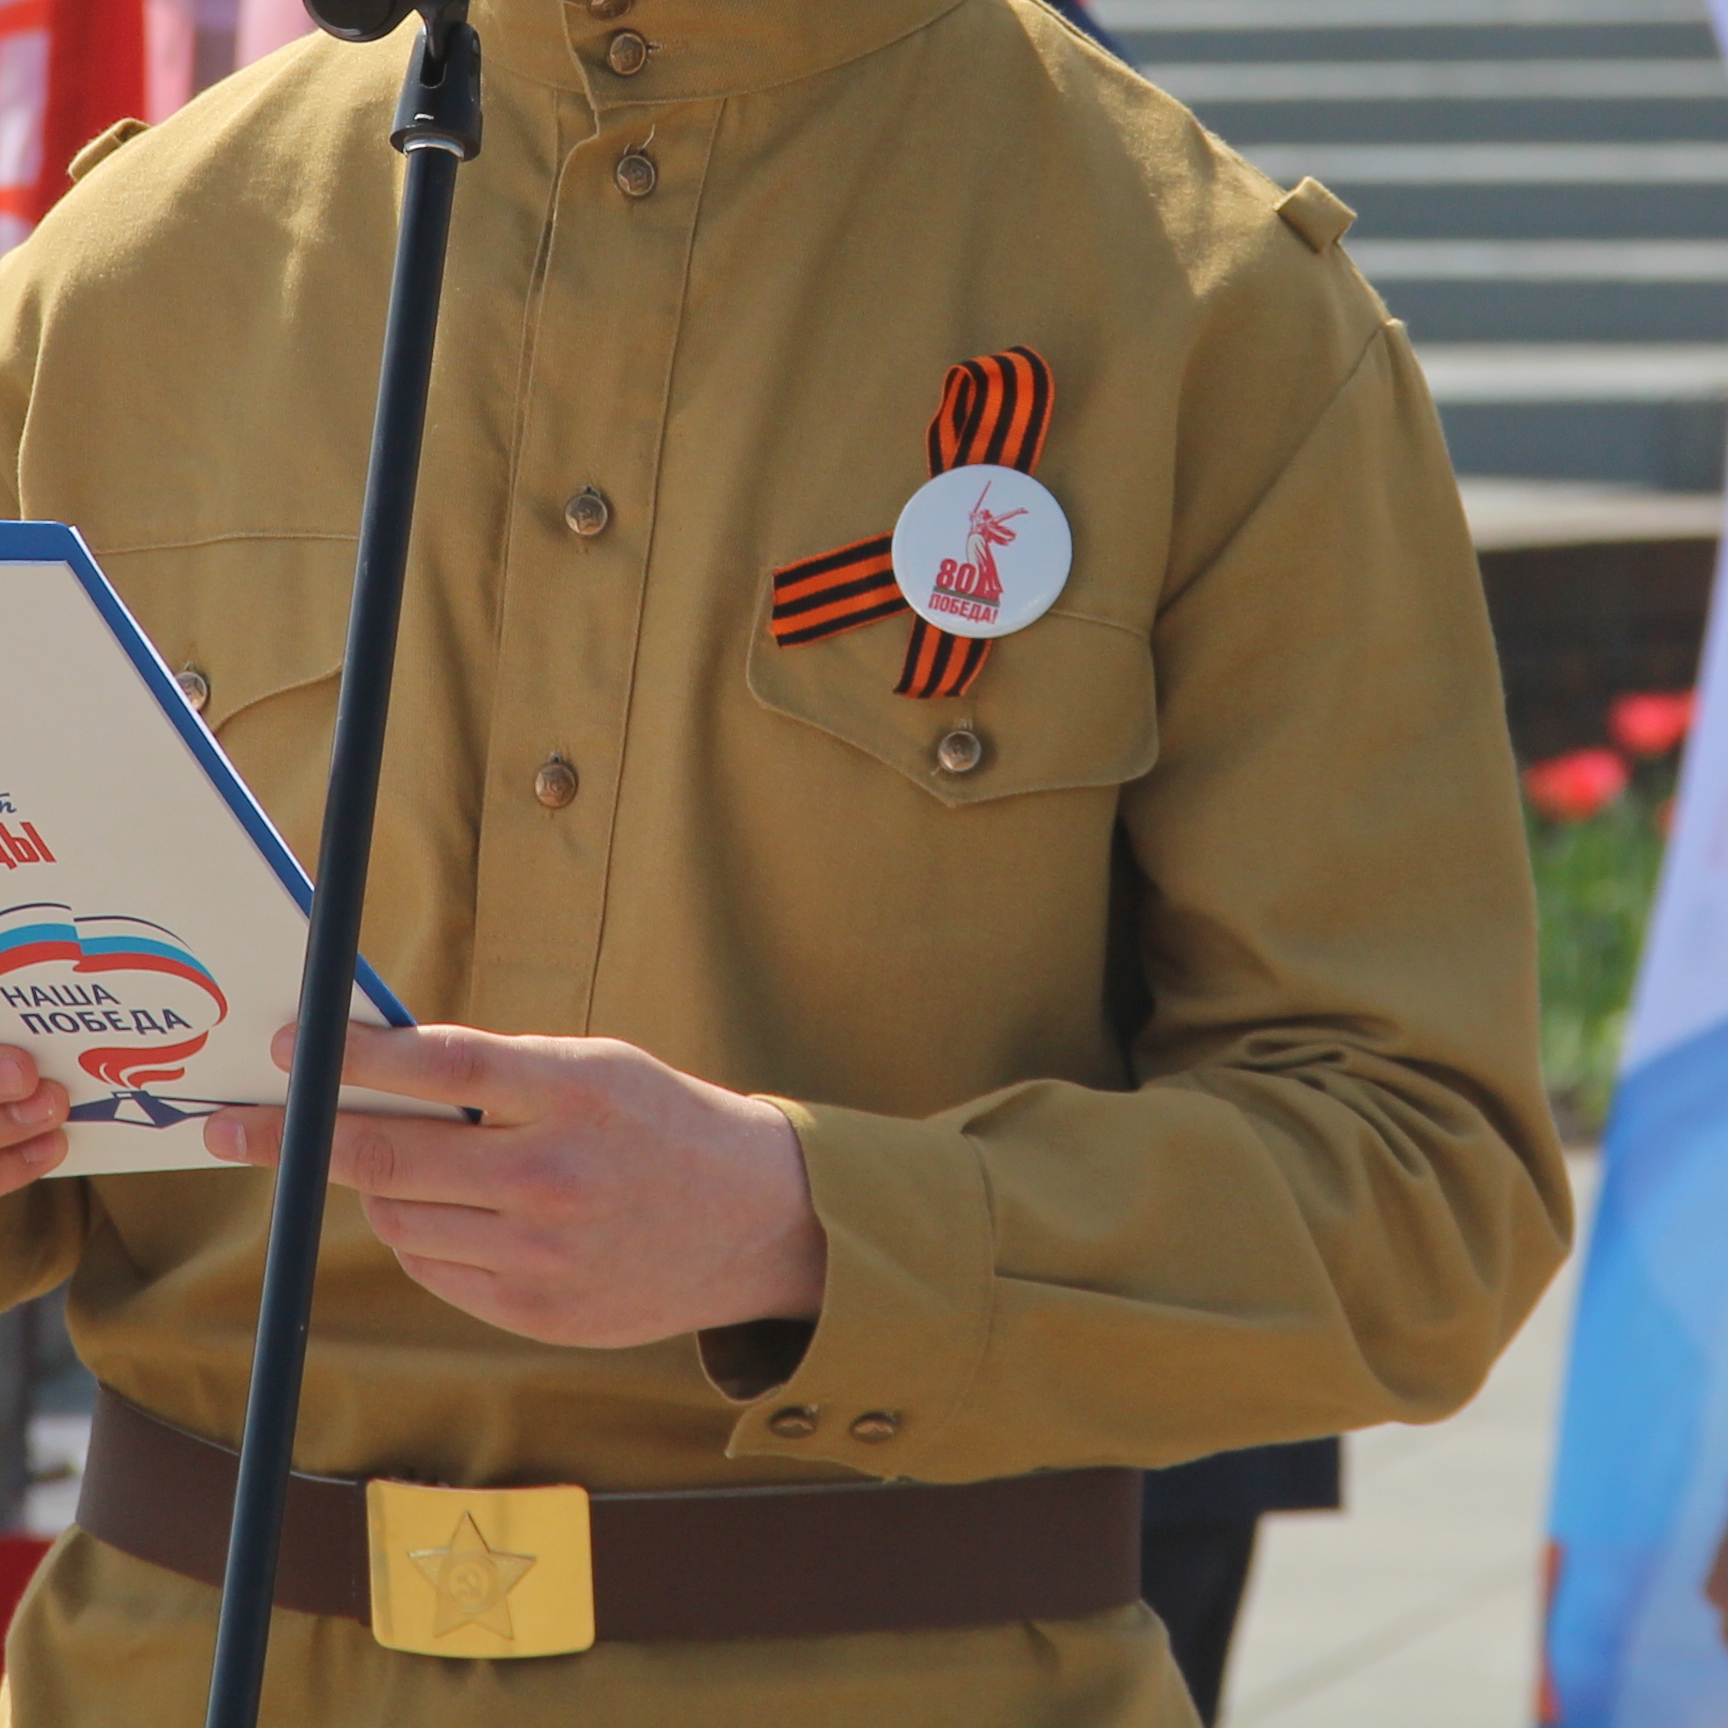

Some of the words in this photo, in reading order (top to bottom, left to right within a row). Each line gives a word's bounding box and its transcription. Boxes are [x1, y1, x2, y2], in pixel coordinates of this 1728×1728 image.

[936, 557, 977, 595] 80
[928, 593, 999, 626] ПОБЕДА!
[19, 1008, 193, 1036] ПОБЕДА
